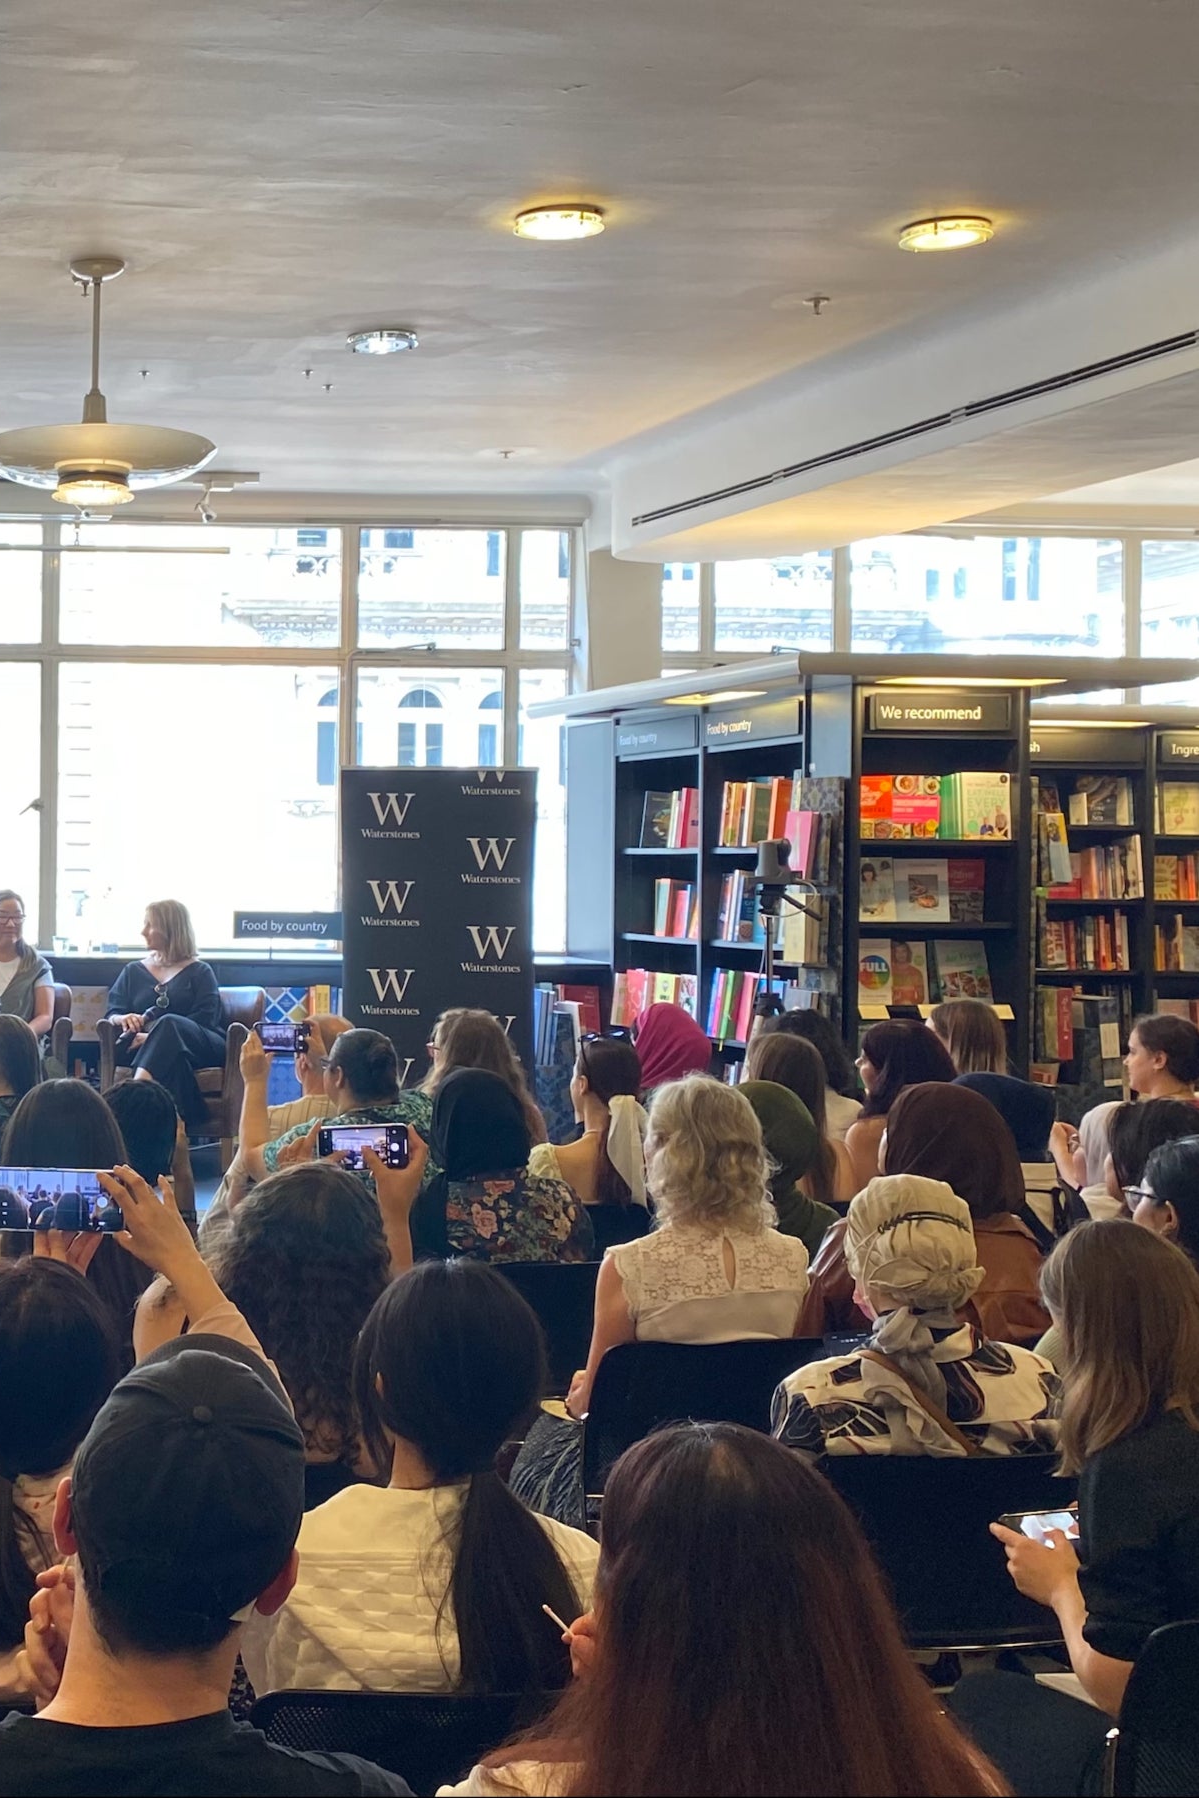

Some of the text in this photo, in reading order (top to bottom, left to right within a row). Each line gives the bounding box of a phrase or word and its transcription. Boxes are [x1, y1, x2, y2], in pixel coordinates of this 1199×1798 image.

[880, 706, 982, 720] We recommend
[706, 720, 752, 736] Food by country
[460, 785, 521, 796] Waterstones
[367, 793, 416, 826] W
[360, 828, 420, 840] Waterstones
[466, 838, 517, 871] W
[460, 873, 521, 884] Waterstones
[366, 880, 416, 914] W
[241, 919, 328, 934] Food by country
[360, 916, 420, 927] Waterstones
[466, 925, 517, 960] W
[460, 962, 521, 973] Waterstones
[860, 962, 888, 973] FULL
[366, 968, 416, 1002] W
[360, 1004, 420, 1016] Waterstones
